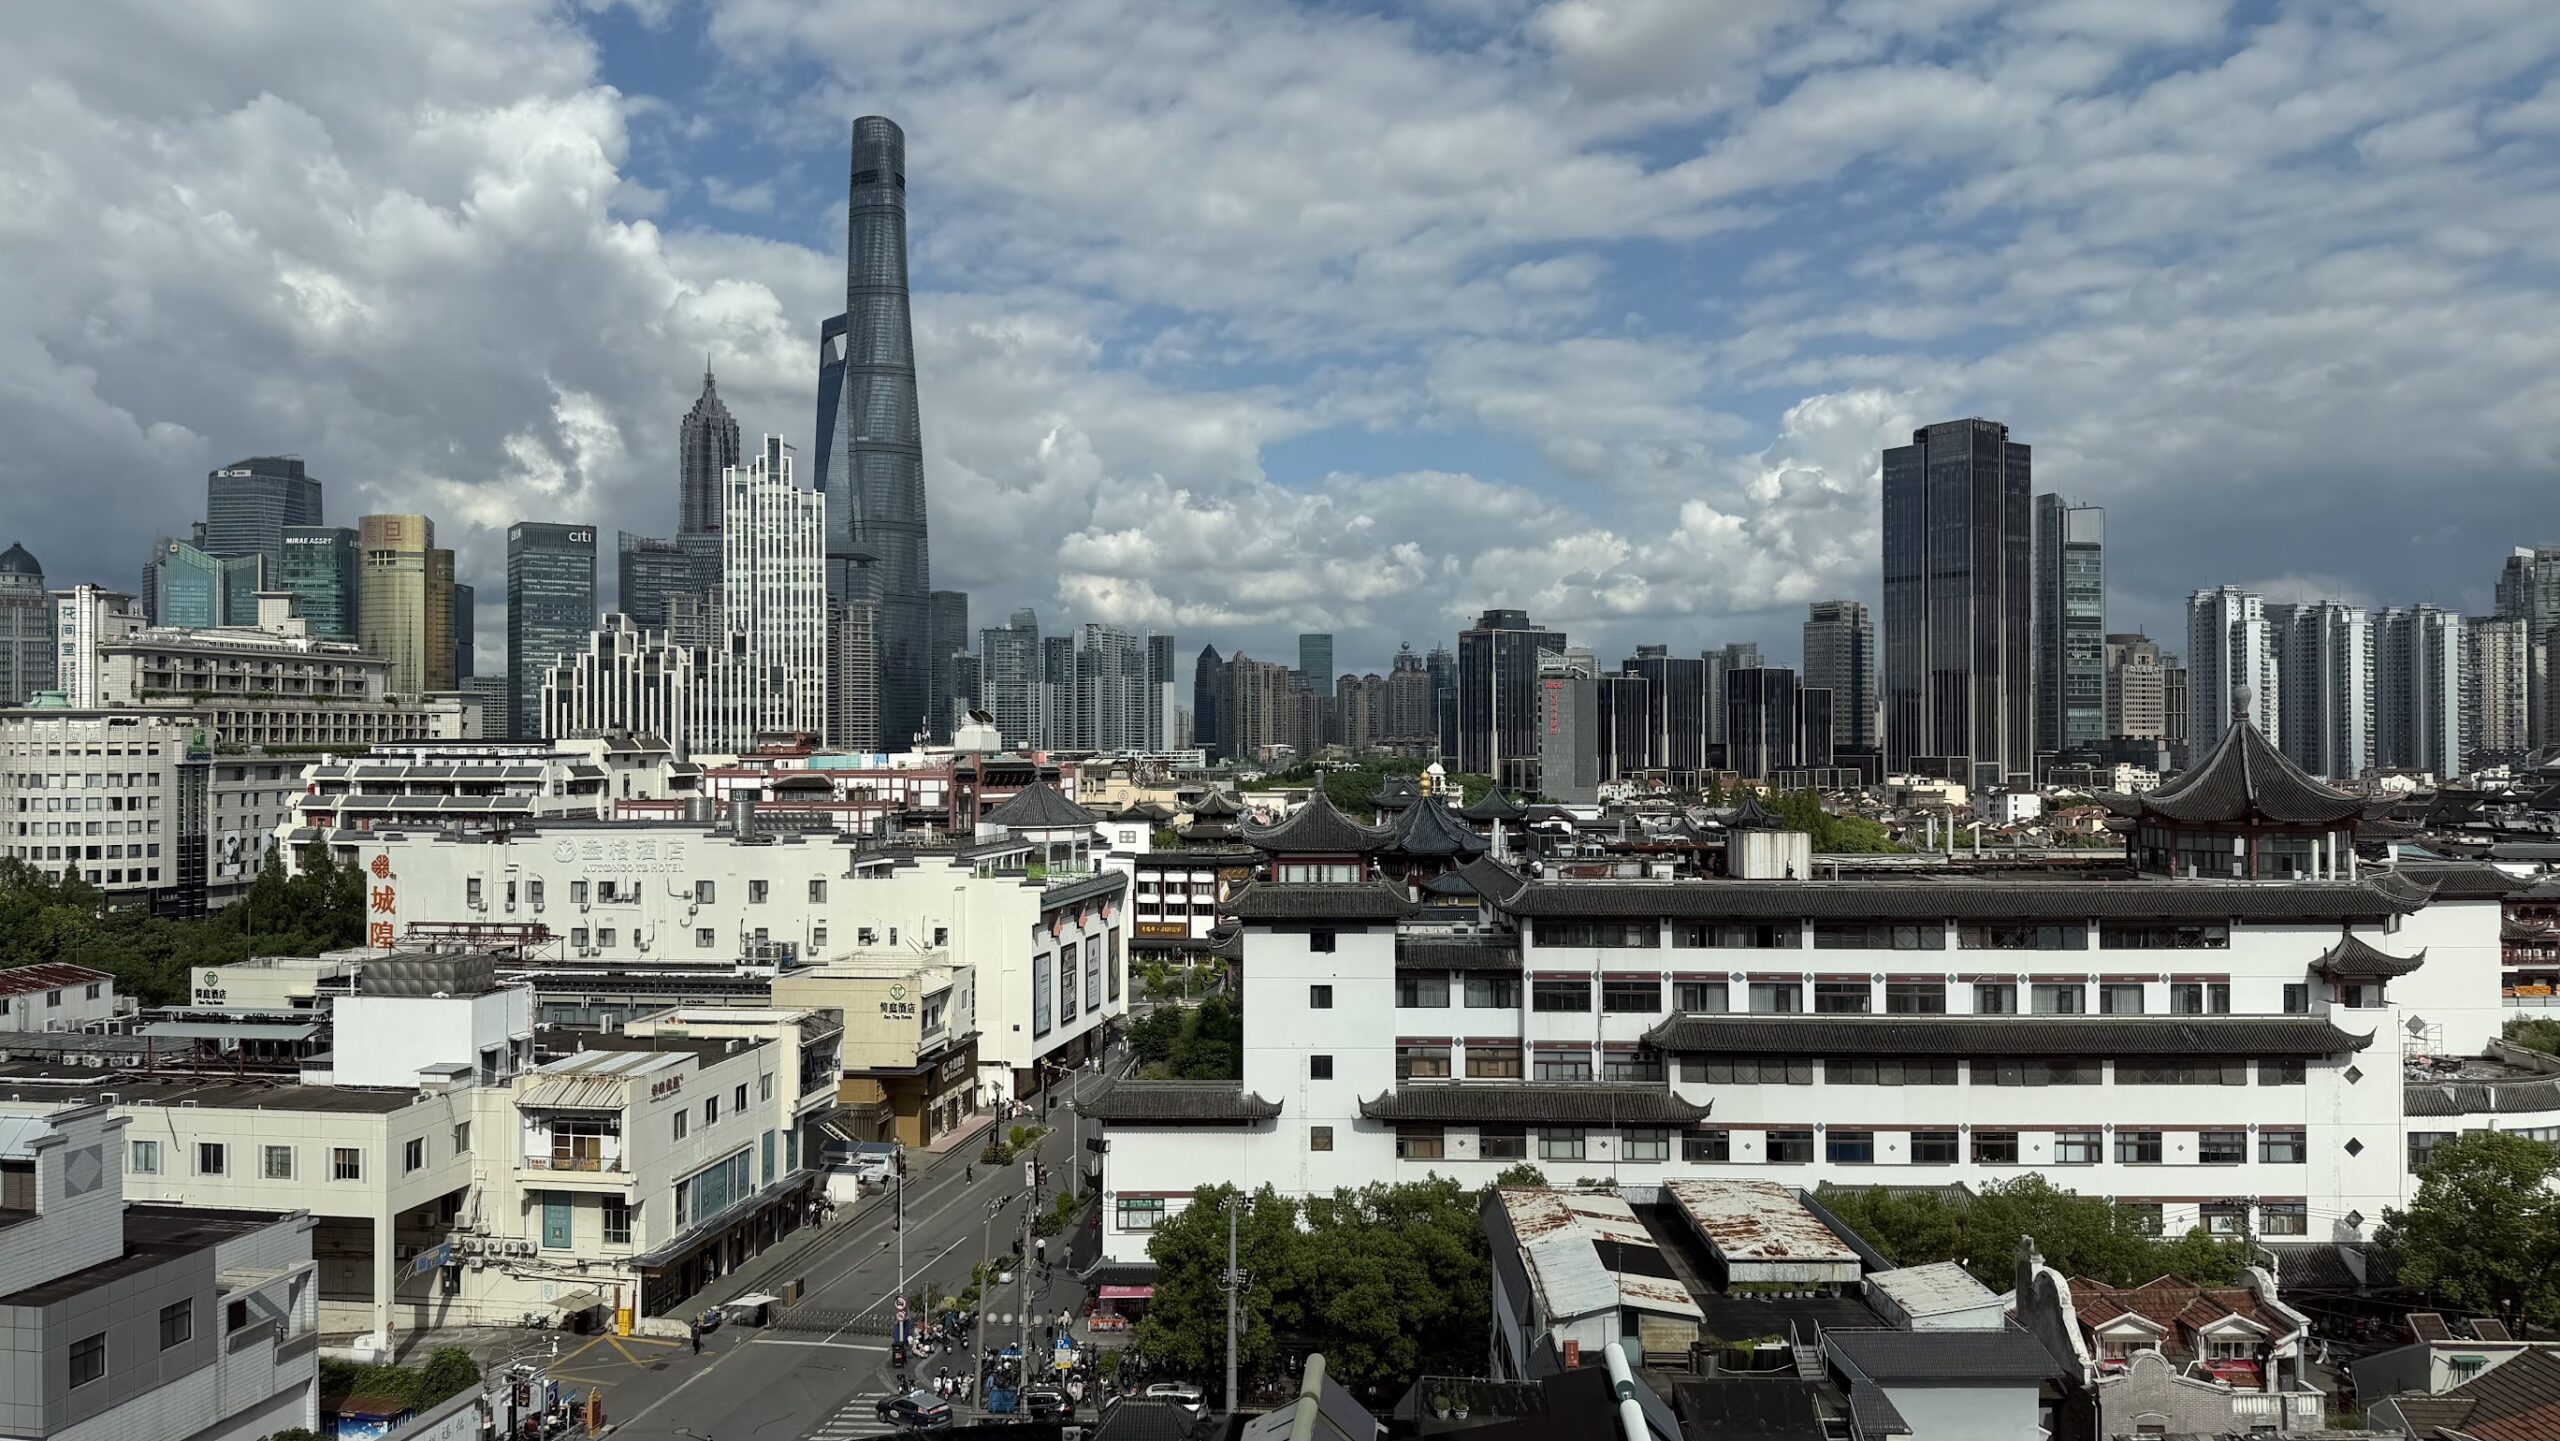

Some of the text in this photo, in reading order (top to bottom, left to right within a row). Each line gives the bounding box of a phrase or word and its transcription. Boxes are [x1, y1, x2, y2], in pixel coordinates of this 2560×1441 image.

[286, 537, 333, 545] MIRAE ASSET
[569, 530, 592, 543] citi
[651, 864, 684, 873] HOTEL
